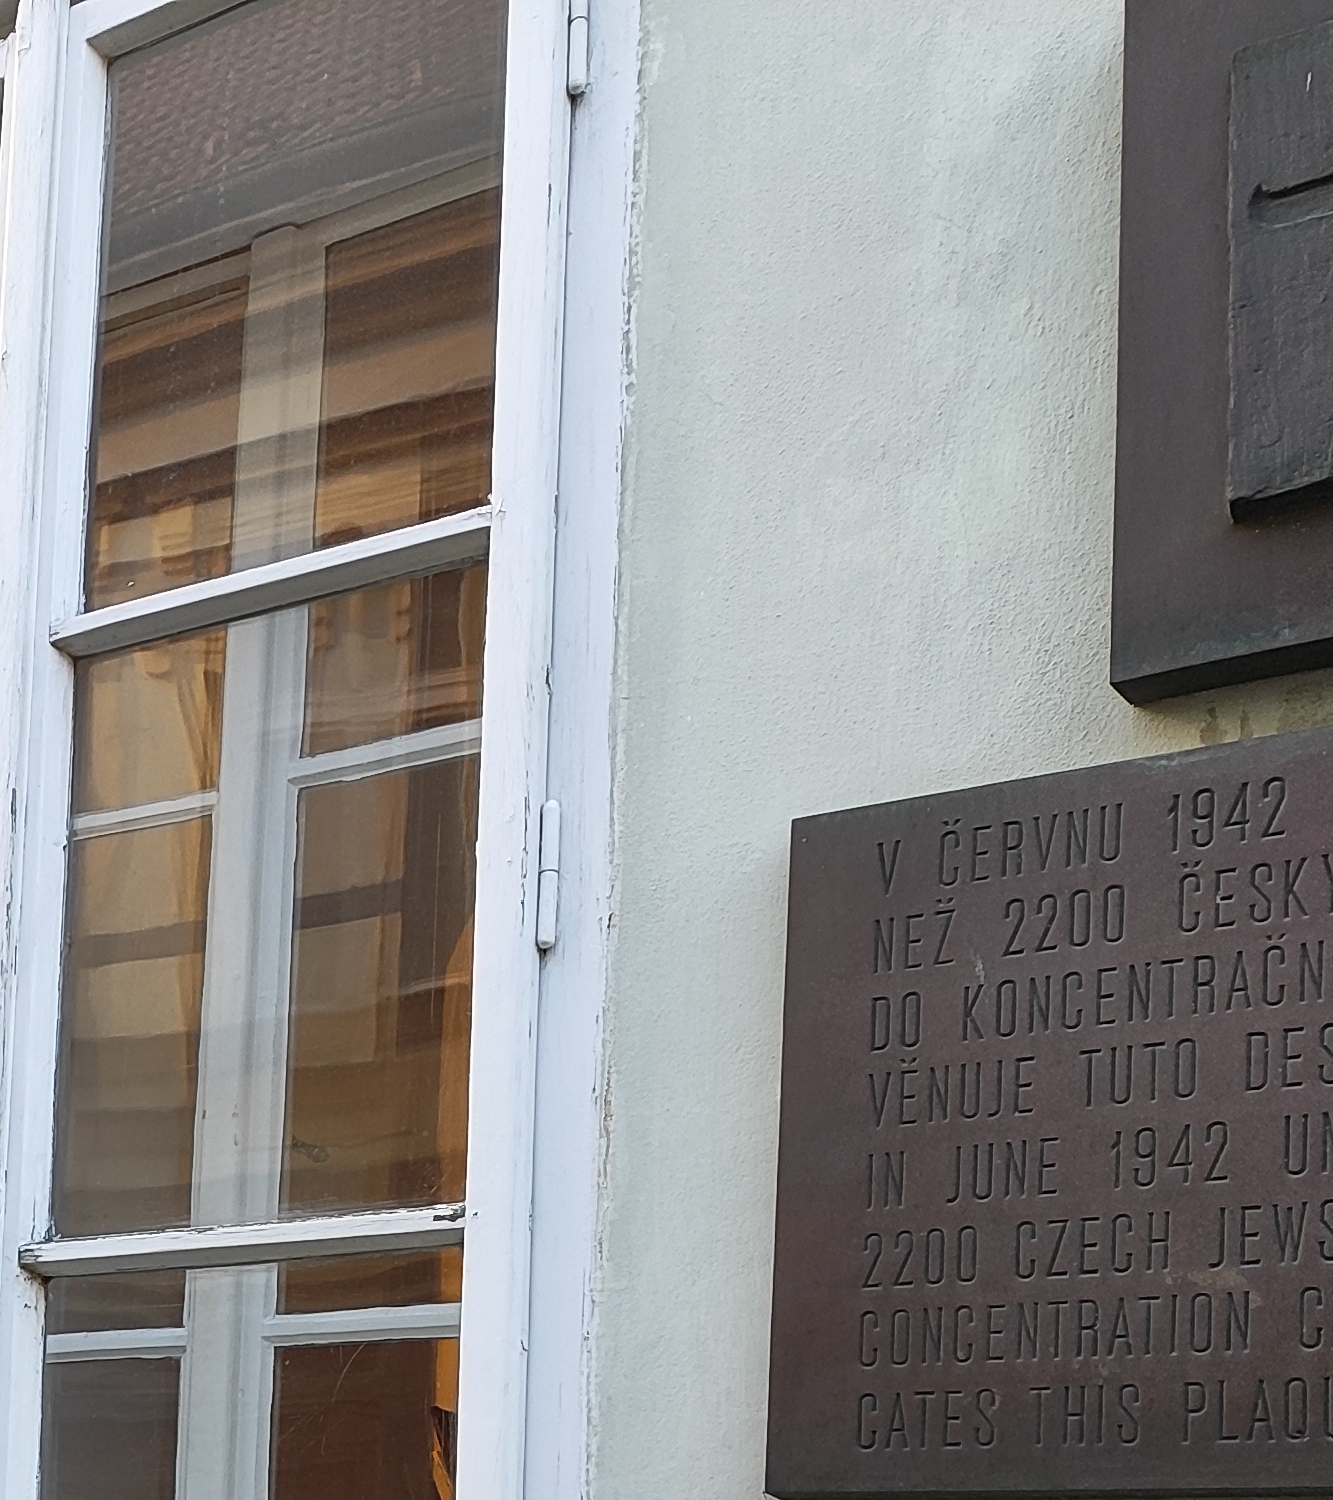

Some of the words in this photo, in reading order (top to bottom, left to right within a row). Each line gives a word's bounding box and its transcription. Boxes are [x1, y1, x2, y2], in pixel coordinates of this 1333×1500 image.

[876, 839, 903, 898] V
[938, 801, 1126, 892] ČERVNU
[1169, 775, 1287, 853] 1942
[872, 897, 958, 976] NEŽ
[1003, 883, 1128, 959] 2200
[869, 990, 923, 1054] DO
[868, 1056, 1037, 1129] VĚNUJE
[1079, 1037, 1199, 1108] TUTO
[866, 1149, 906, 1211] IN
[945, 1136, 1061, 1207] JUNE
[1109, 1120, 1230, 1193] 1942
[861, 1224, 978, 1291] 2200
[1013, 1211, 1173, 1283] CZECH
[858, 1290, 1253, 1370] CONCENTRATION
[855, 1388, 998, 1453] CATES
[1031, 1382, 1142, 1448] THIS
